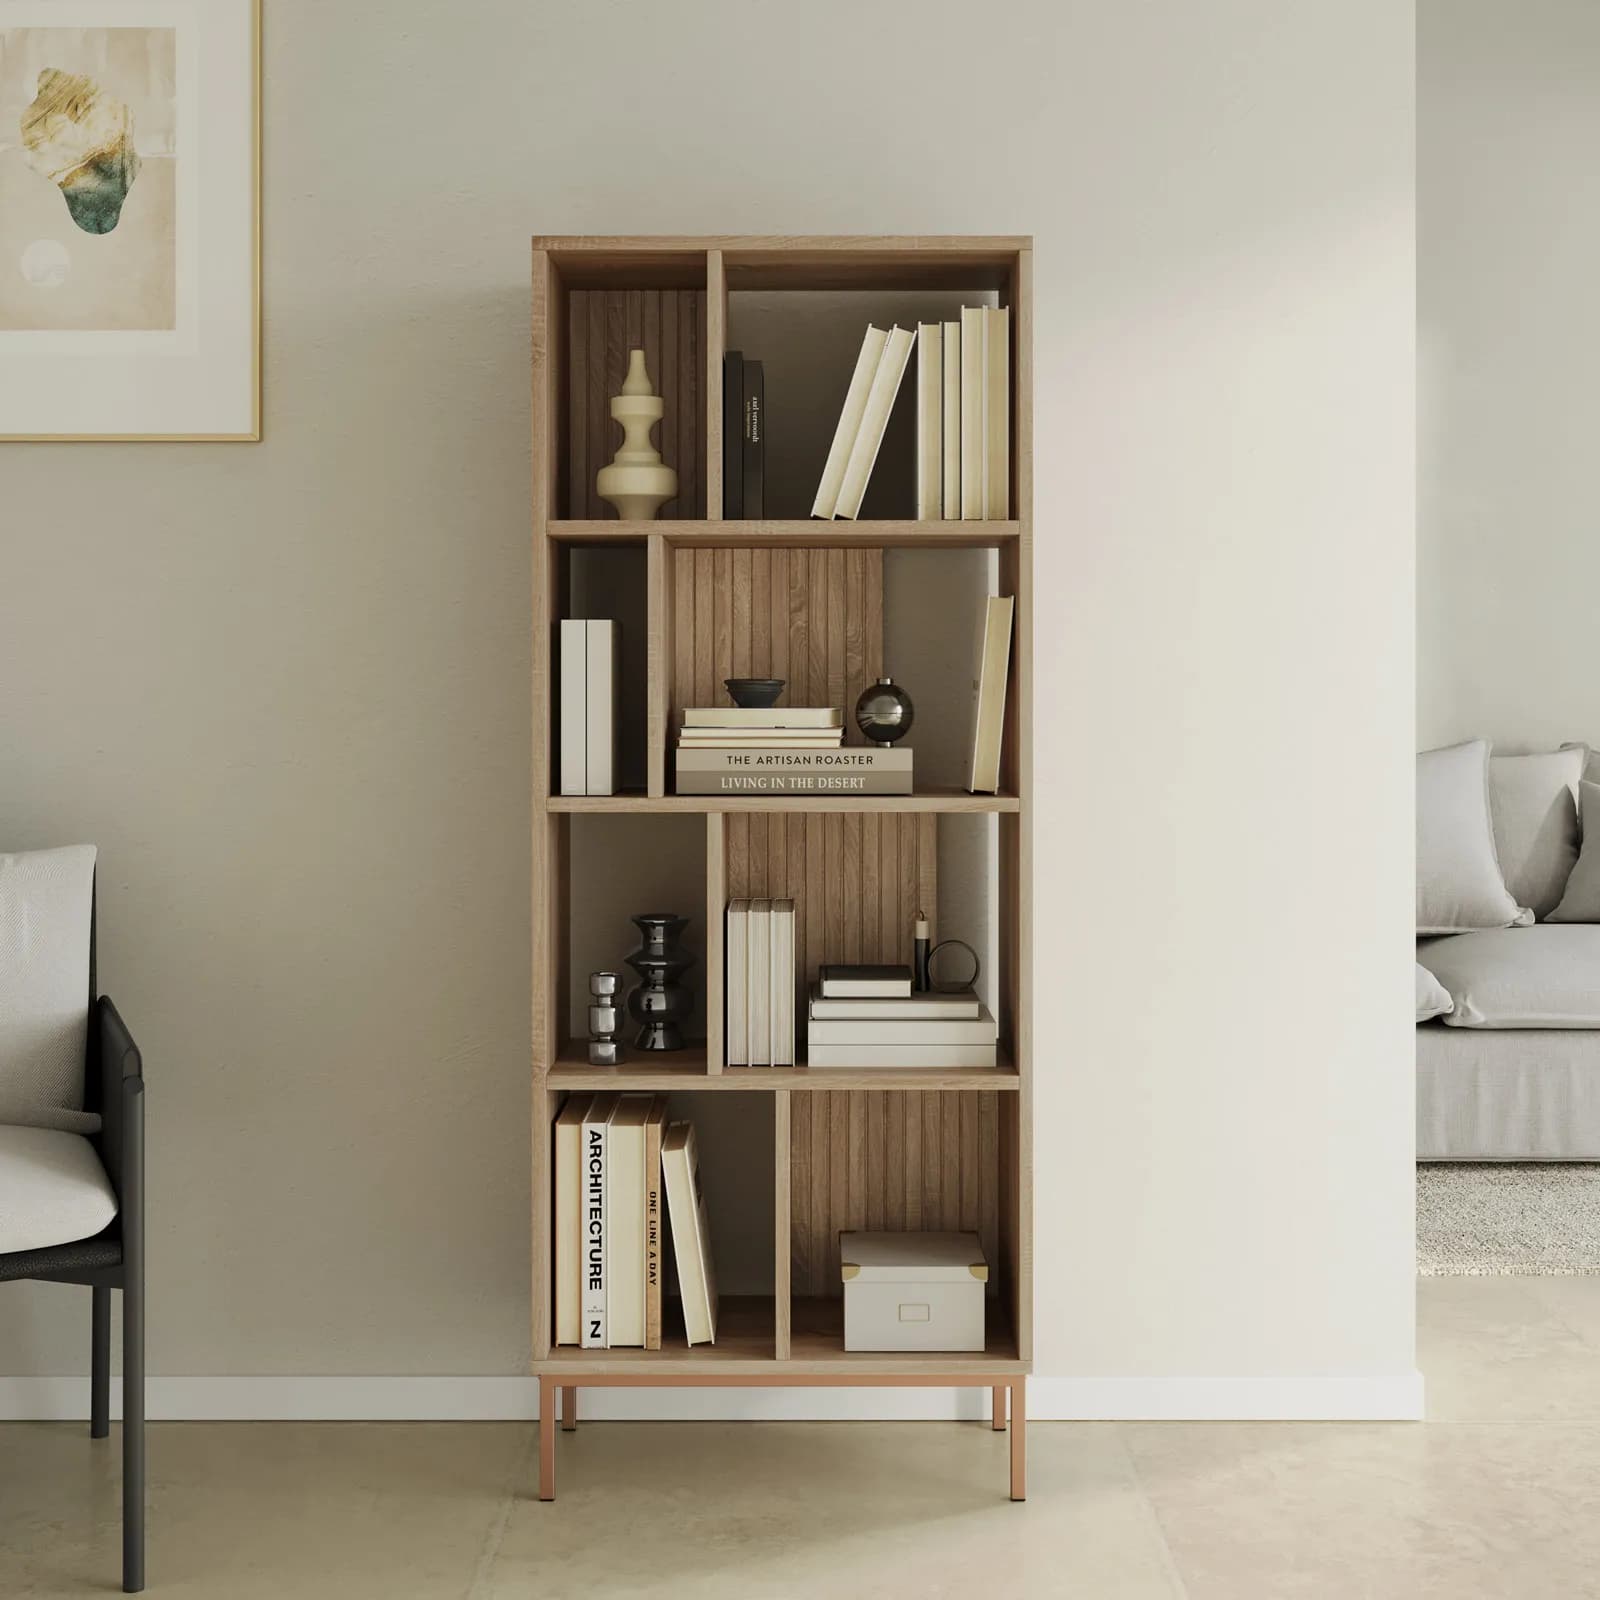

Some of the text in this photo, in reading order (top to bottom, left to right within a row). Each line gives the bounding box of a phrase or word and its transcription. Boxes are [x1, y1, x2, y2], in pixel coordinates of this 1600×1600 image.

[752, 411, 760, 443] vervoordt
[726, 755, 874, 765] THE ARTISAN ROASTER
[720, 777, 866, 789] LIVING IN THE DESERT
[589, 1130, 603, 1291] ARCHITECTURE
[648, 1191, 657, 1286] ONE LINE A DAY
